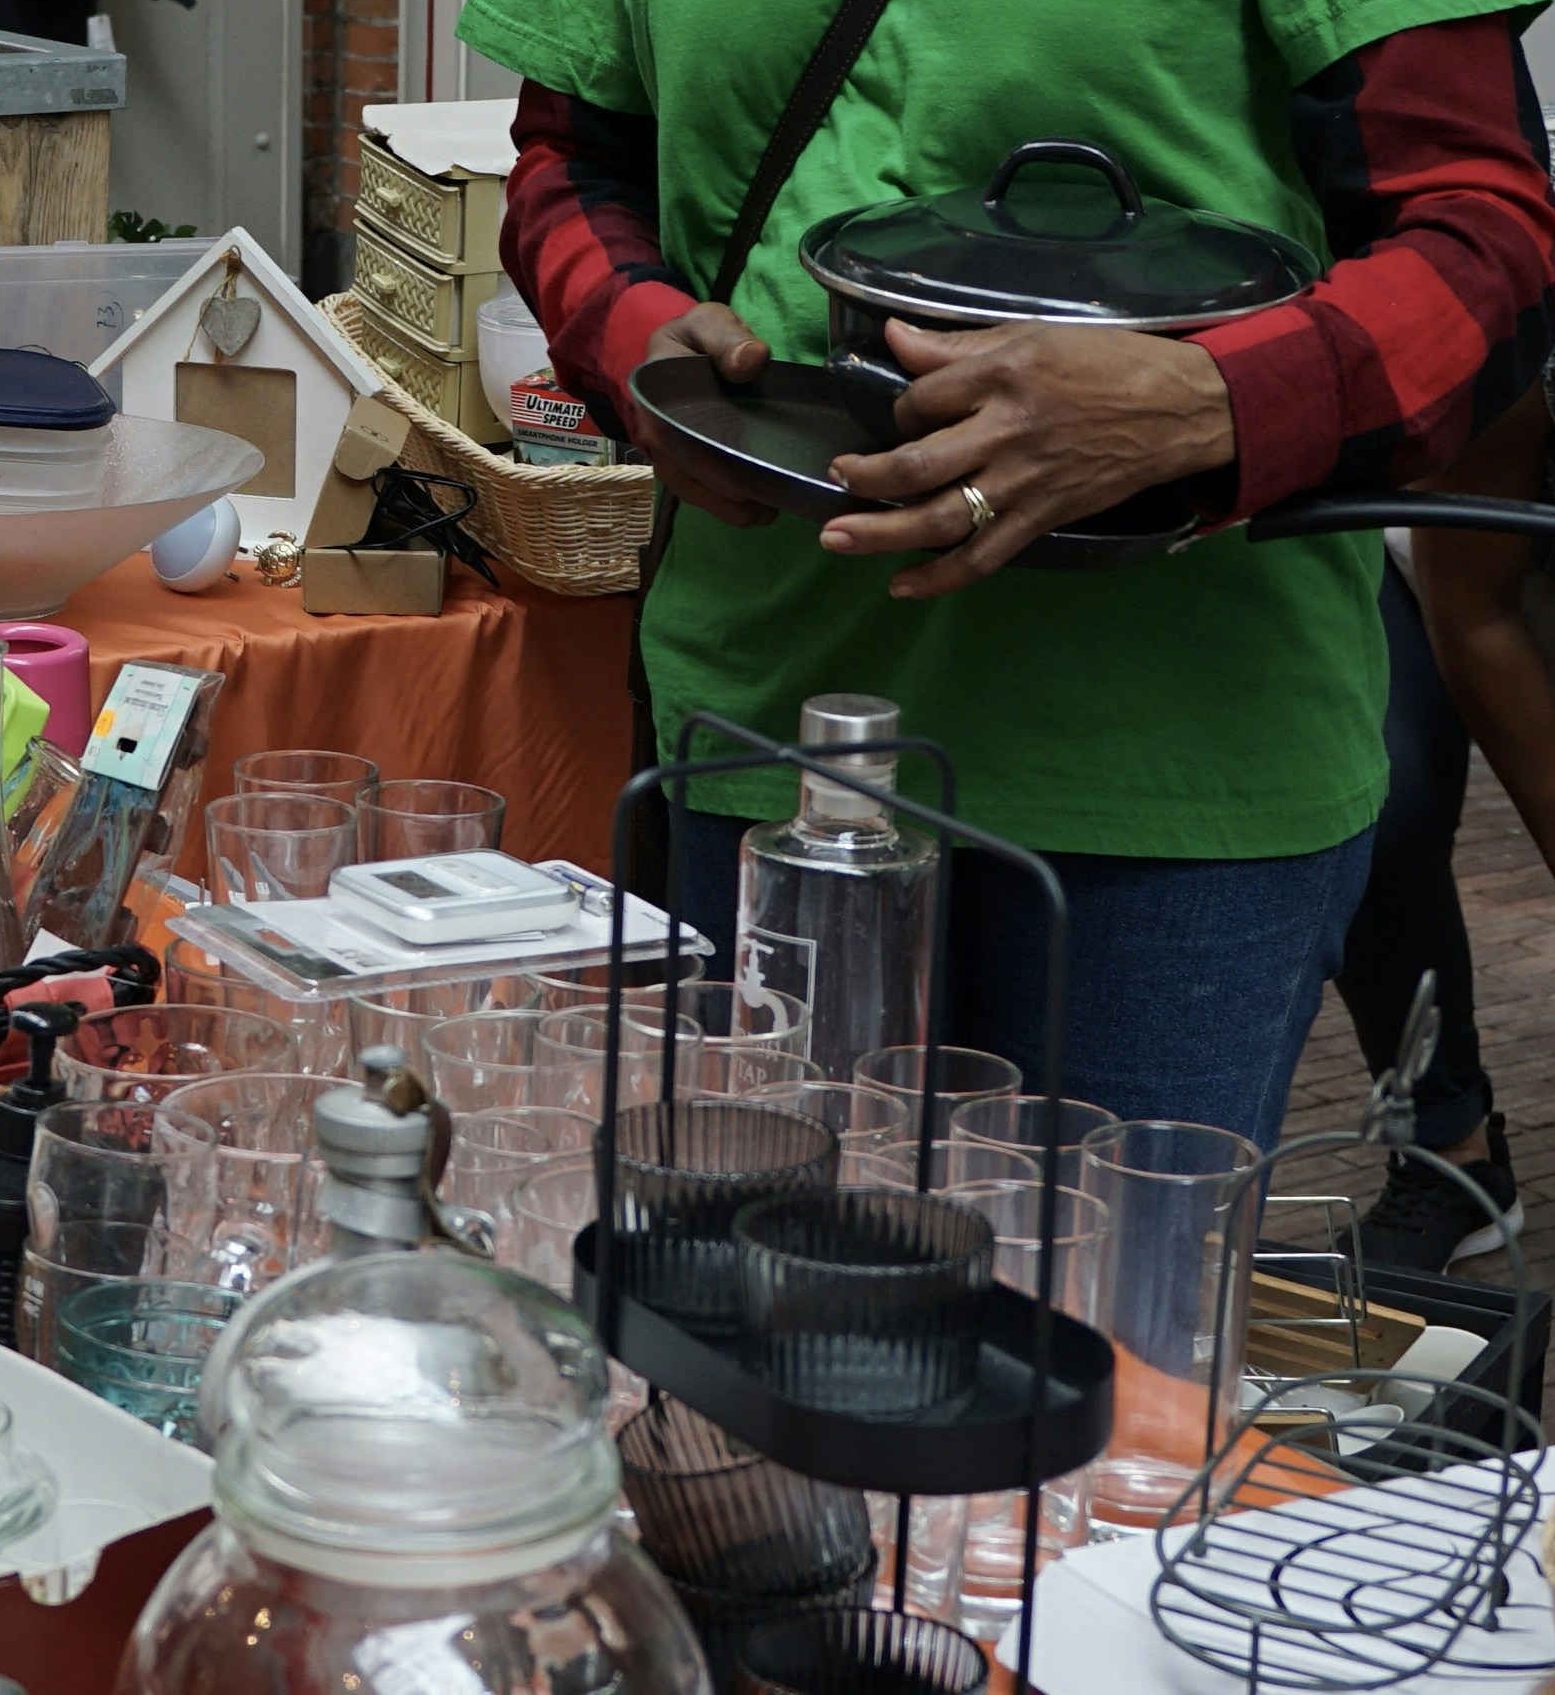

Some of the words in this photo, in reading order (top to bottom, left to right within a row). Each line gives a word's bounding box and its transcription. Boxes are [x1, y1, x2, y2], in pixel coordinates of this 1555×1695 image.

[525, 394, 585, 418] ULTIMATE
[542, 412, 578, 429] SPEED
[517, 427, 566, 444] SMARTPHONE
[567, 436, 599, 448] HOLDER
